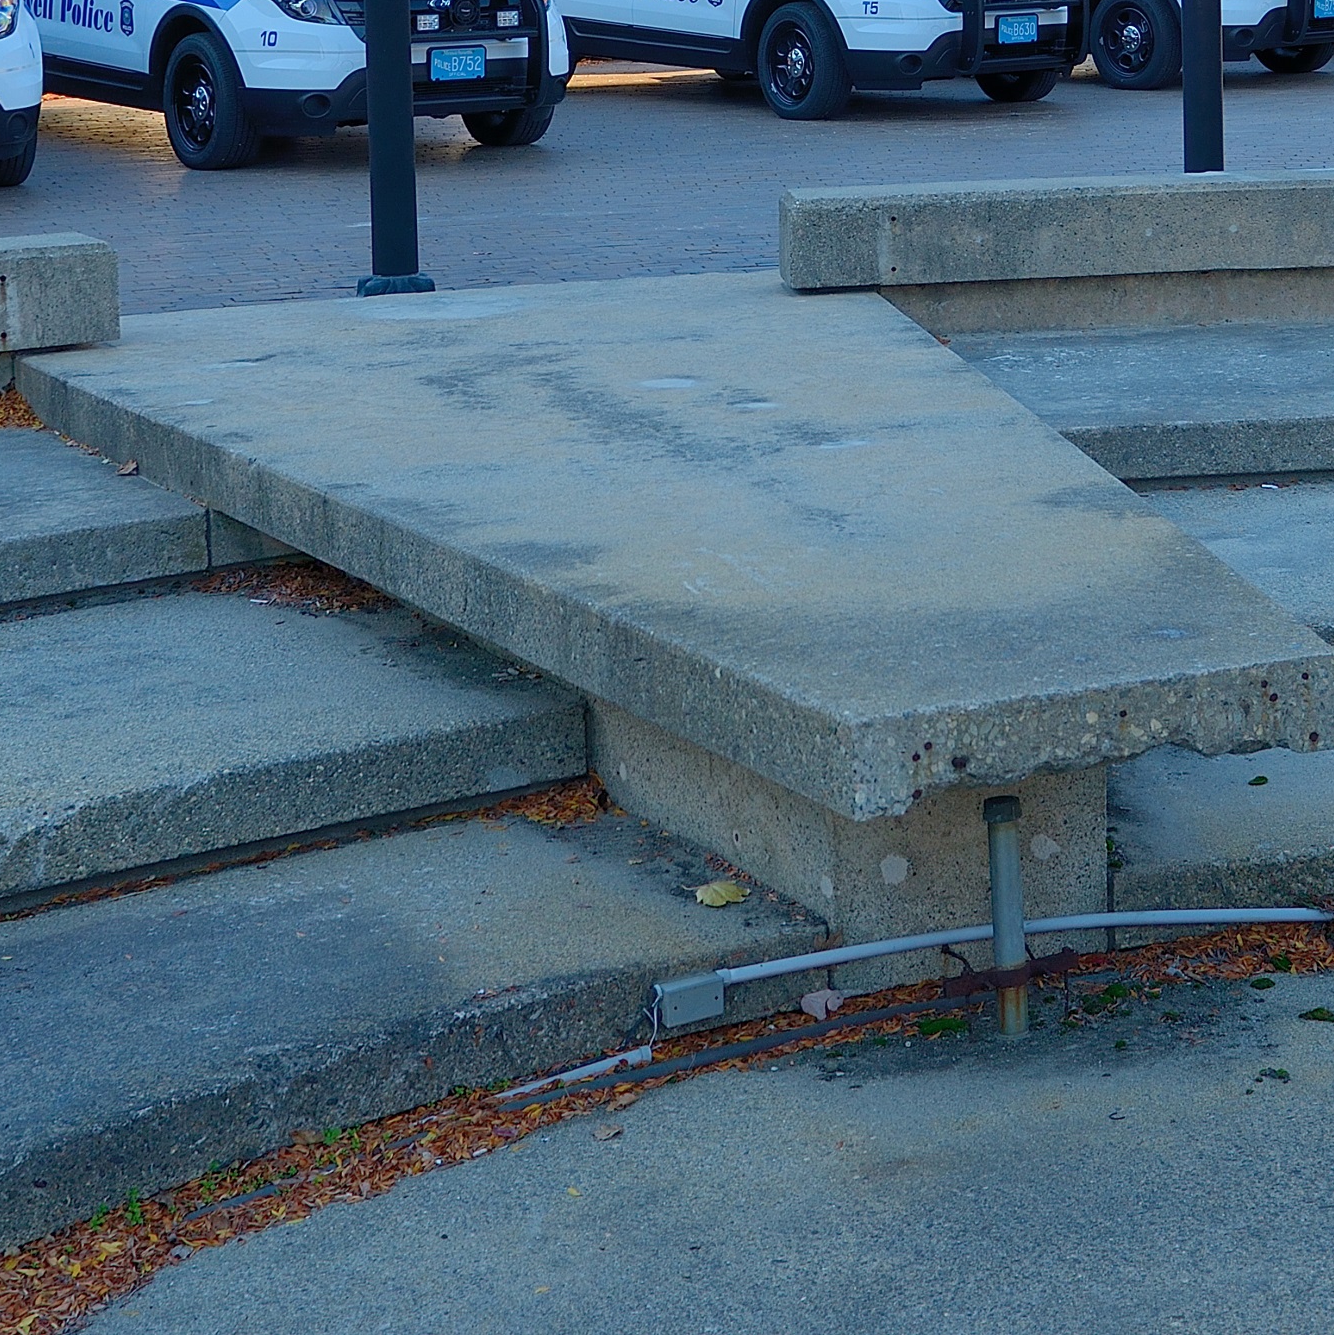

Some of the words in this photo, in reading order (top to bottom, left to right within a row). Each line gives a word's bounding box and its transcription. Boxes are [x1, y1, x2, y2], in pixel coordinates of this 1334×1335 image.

[862, 1, 879, 15] T5
[1013, 22, 1036, 36] B630
[260, 30, 278, 47] 10
[434, 58, 451, 72] POLICE
[451, 55, 482, 72] B752
